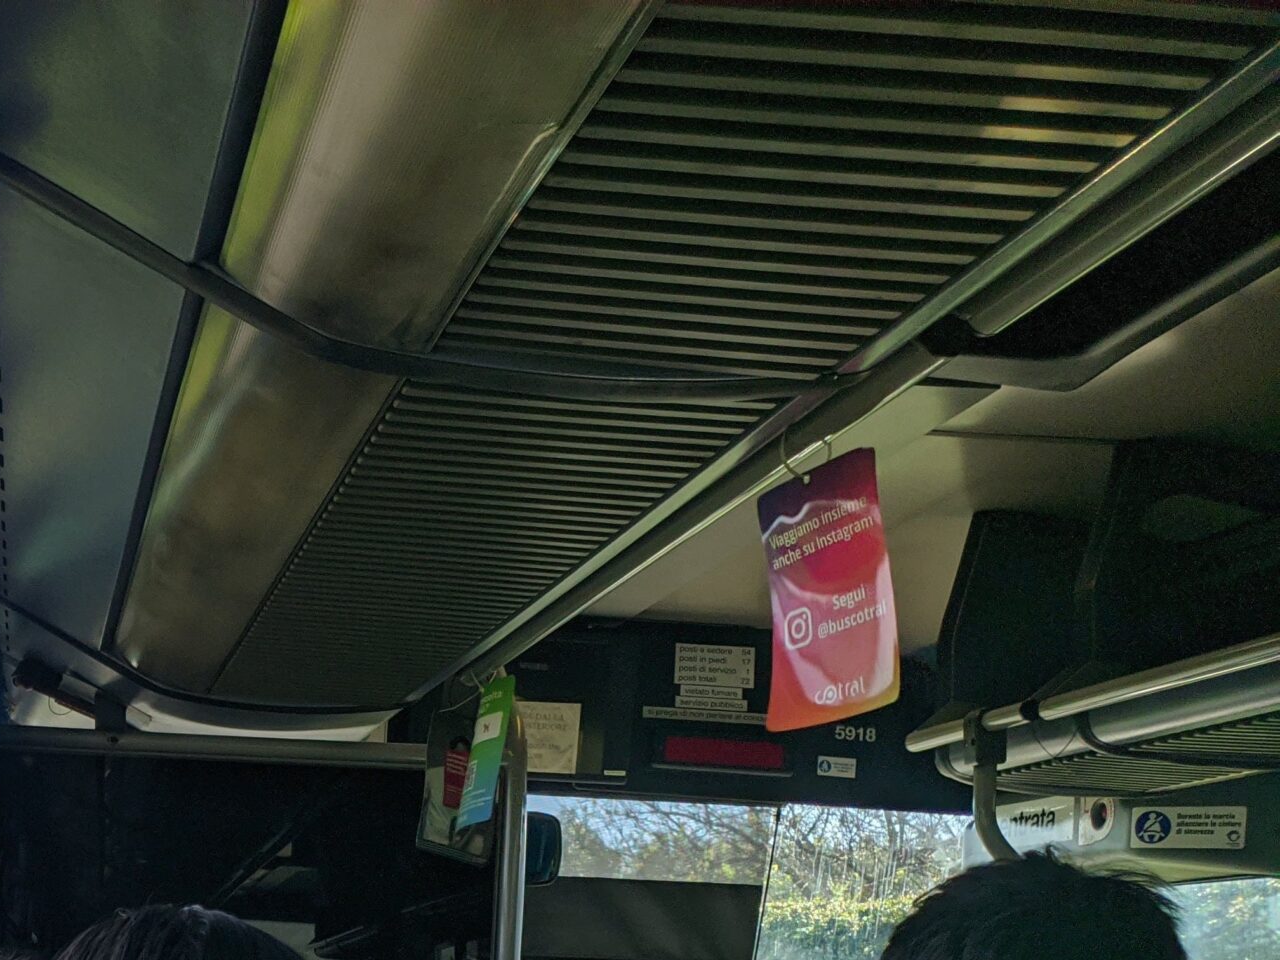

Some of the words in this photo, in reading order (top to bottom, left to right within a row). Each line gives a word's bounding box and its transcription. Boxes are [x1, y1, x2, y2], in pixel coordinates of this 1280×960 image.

[769, 515, 820, 550] Viaggiamo
[821, 496, 867, 526] insieme
[772, 546, 803, 570] anche
[803, 542, 815, 557] su
[816, 516, 874, 550] Instagram
[832, 584, 866, 610] Segui
[818, 600, 888, 639] @buscotral
[679, 646, 699, 655] posti
[706, 647, 733, 656] sedere
[678, 665, 698, 673] posti
[679, 656, 698, 664] posti
[708, 657, 727, 665] piedi
[678, 675, 697, 683] posti
[835, 725, 876, 742] 5918
